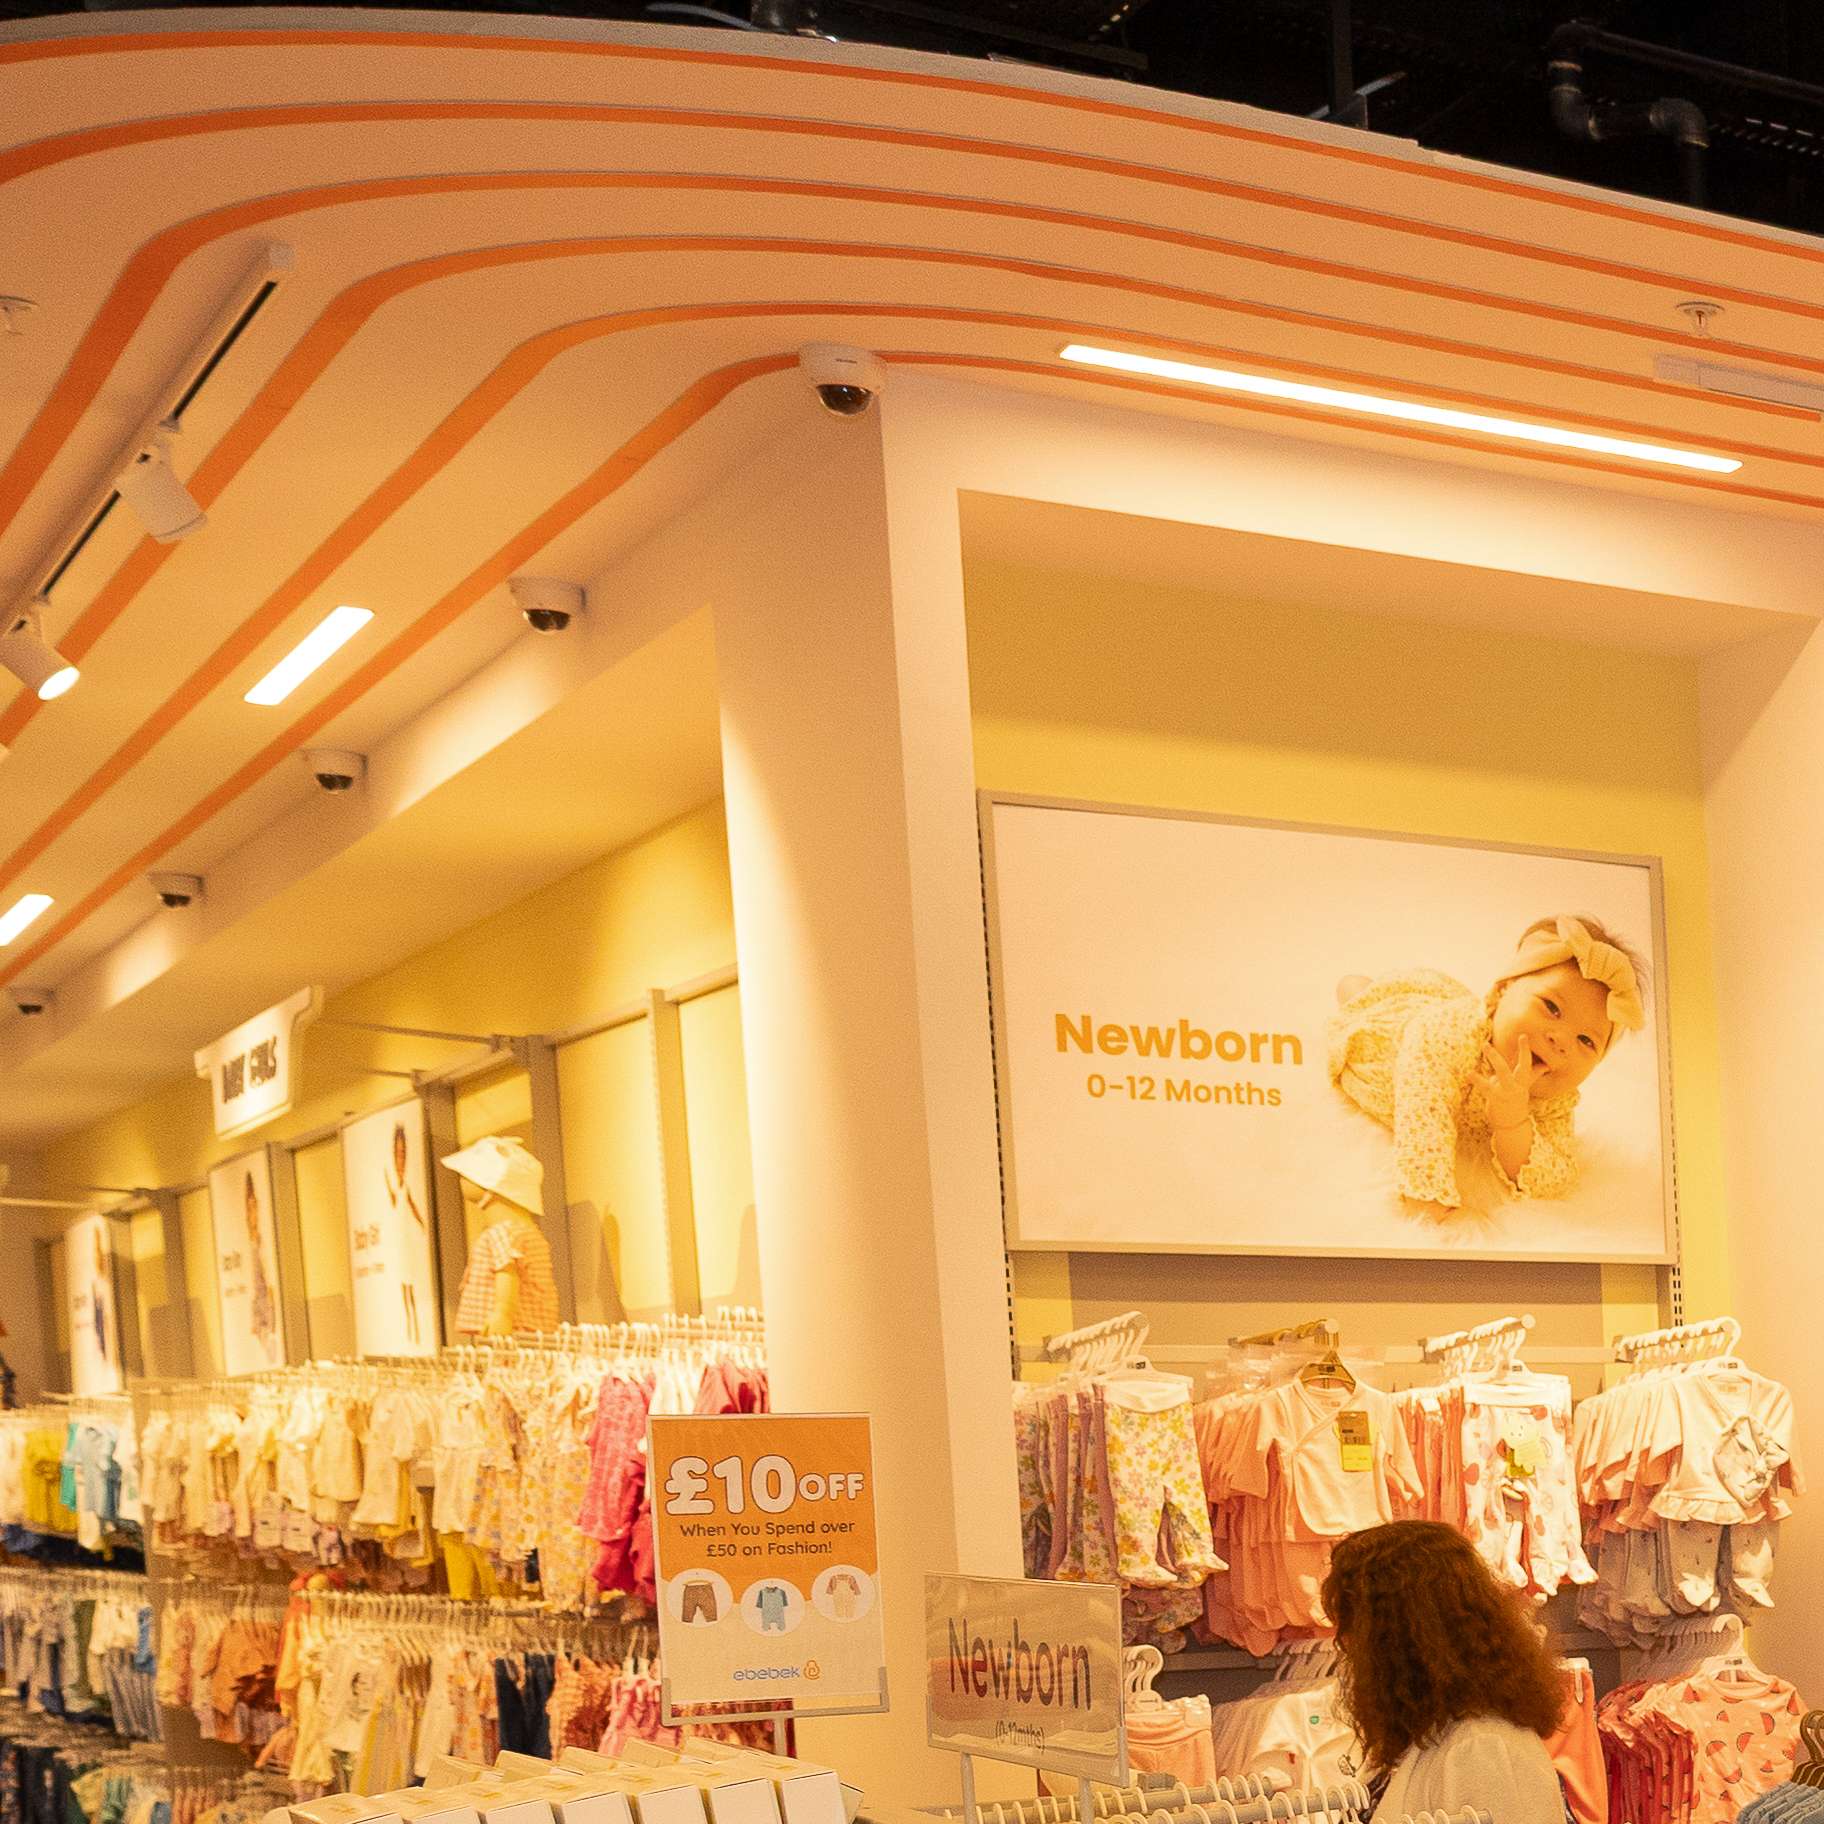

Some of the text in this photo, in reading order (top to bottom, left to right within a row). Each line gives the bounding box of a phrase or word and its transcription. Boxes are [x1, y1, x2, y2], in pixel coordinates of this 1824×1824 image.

[1055, 1013, 1303, 1065] Newborn
[1087, 1074, 1282, 1107] 0-12 Months
[665, 1454, 864, 1515] £10 OFF
[680, 1521, 855, 1538] When You Spend over
[707, 1541, 832, 1557] £50 on Fashion!
[733, 1667, 800, 1681] ebebek
[949, 1617, 1092, 1711] Newborn
